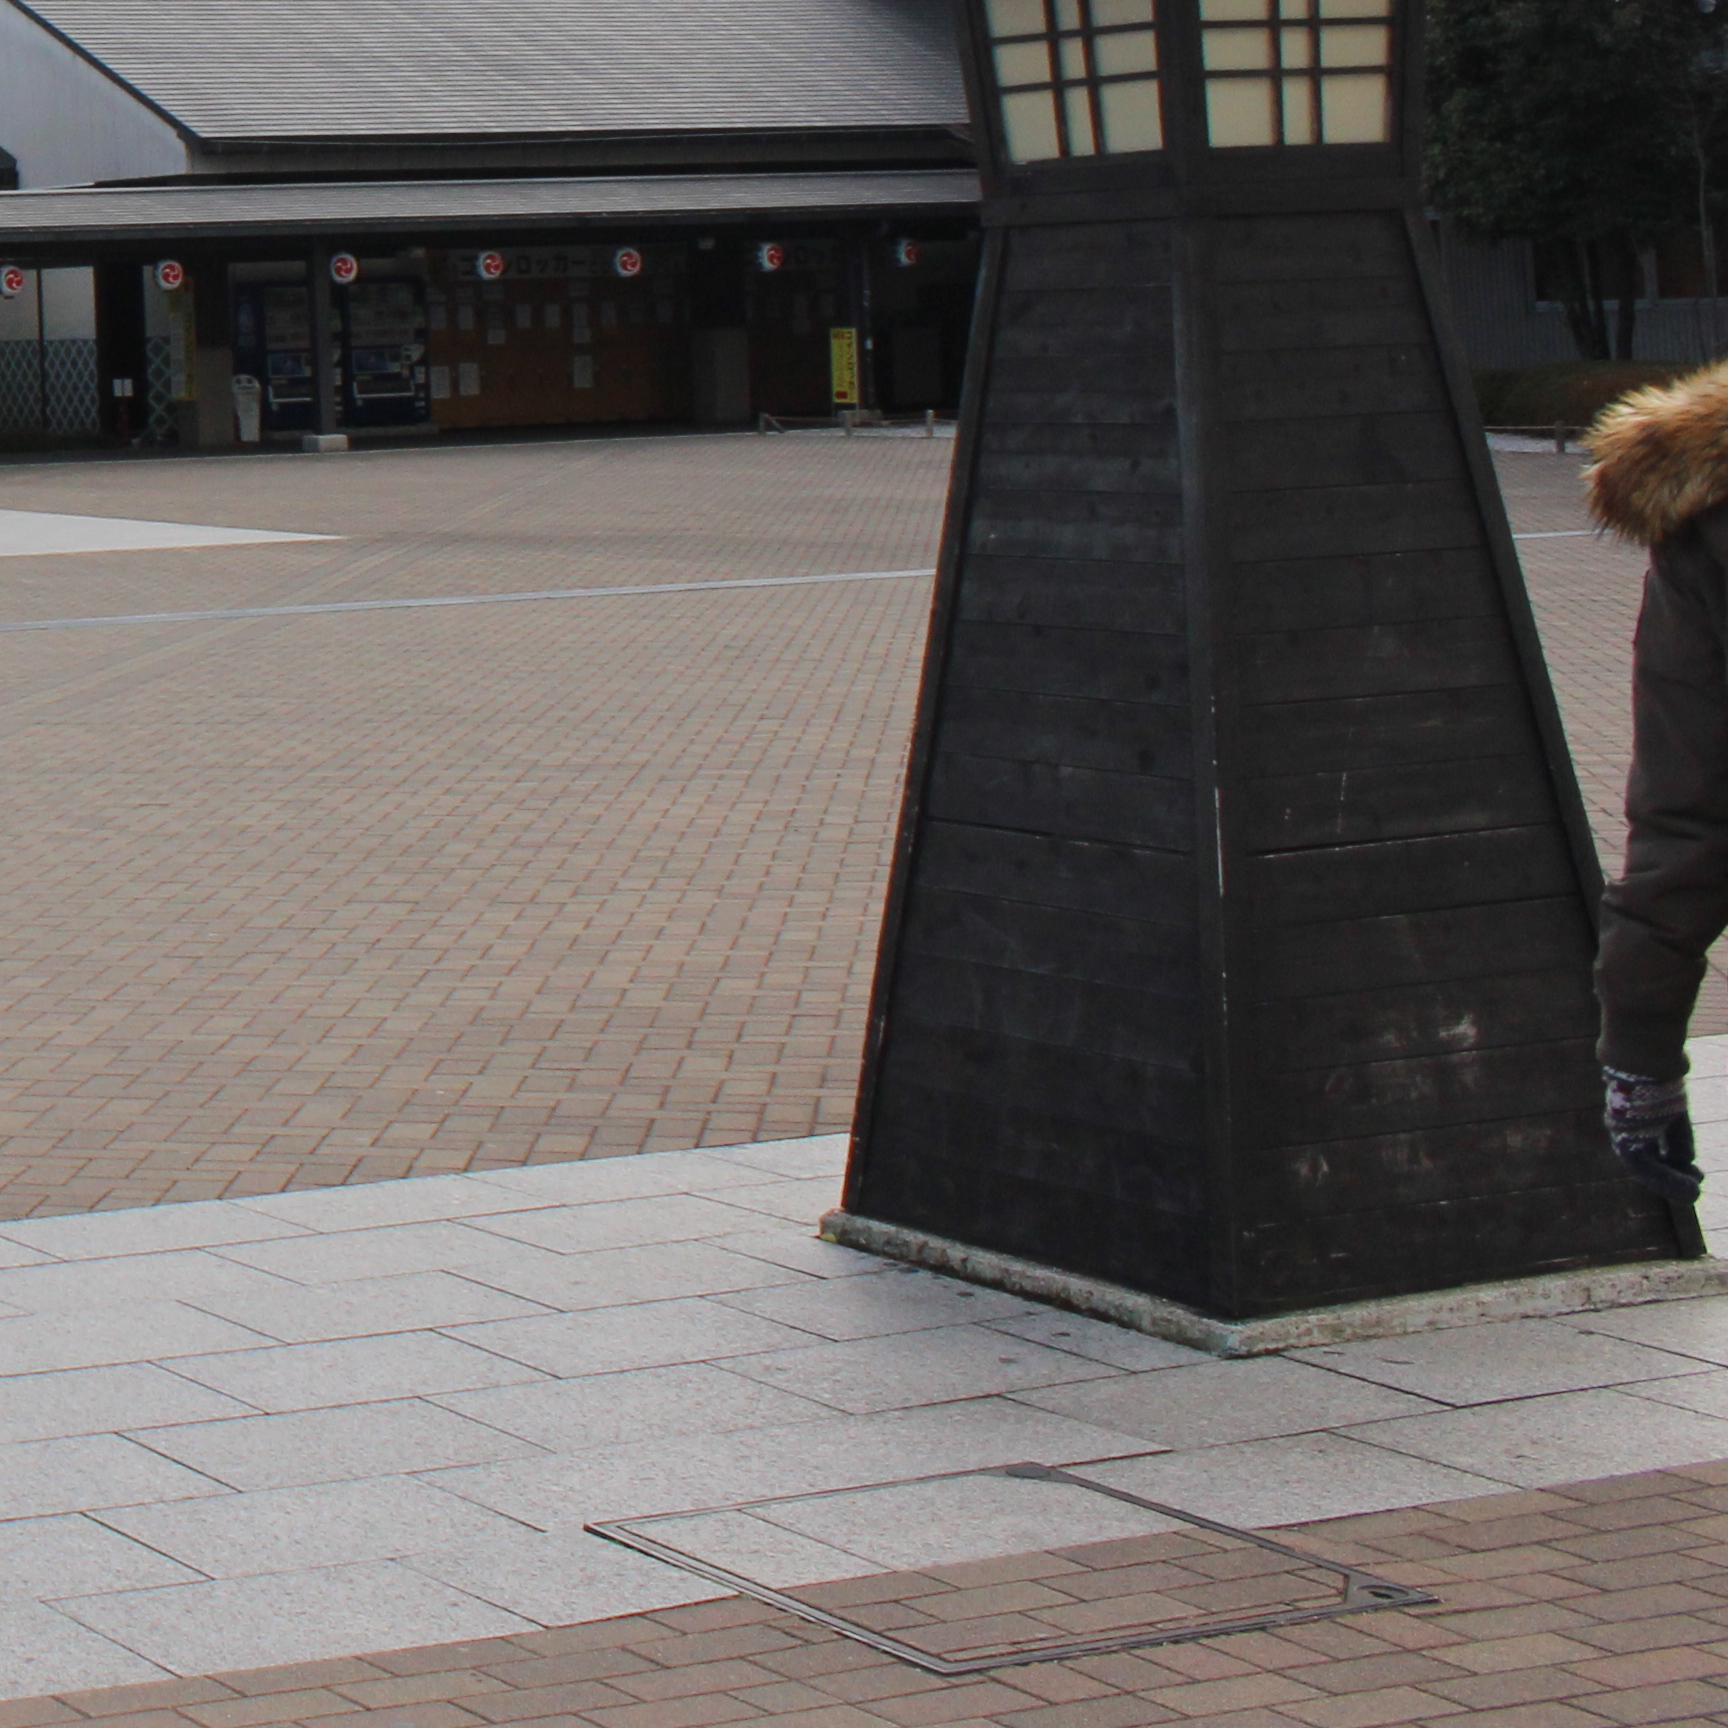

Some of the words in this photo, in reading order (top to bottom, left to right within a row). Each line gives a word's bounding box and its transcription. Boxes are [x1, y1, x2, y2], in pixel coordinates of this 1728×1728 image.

[460, 254, 587, 275] コロッカー
